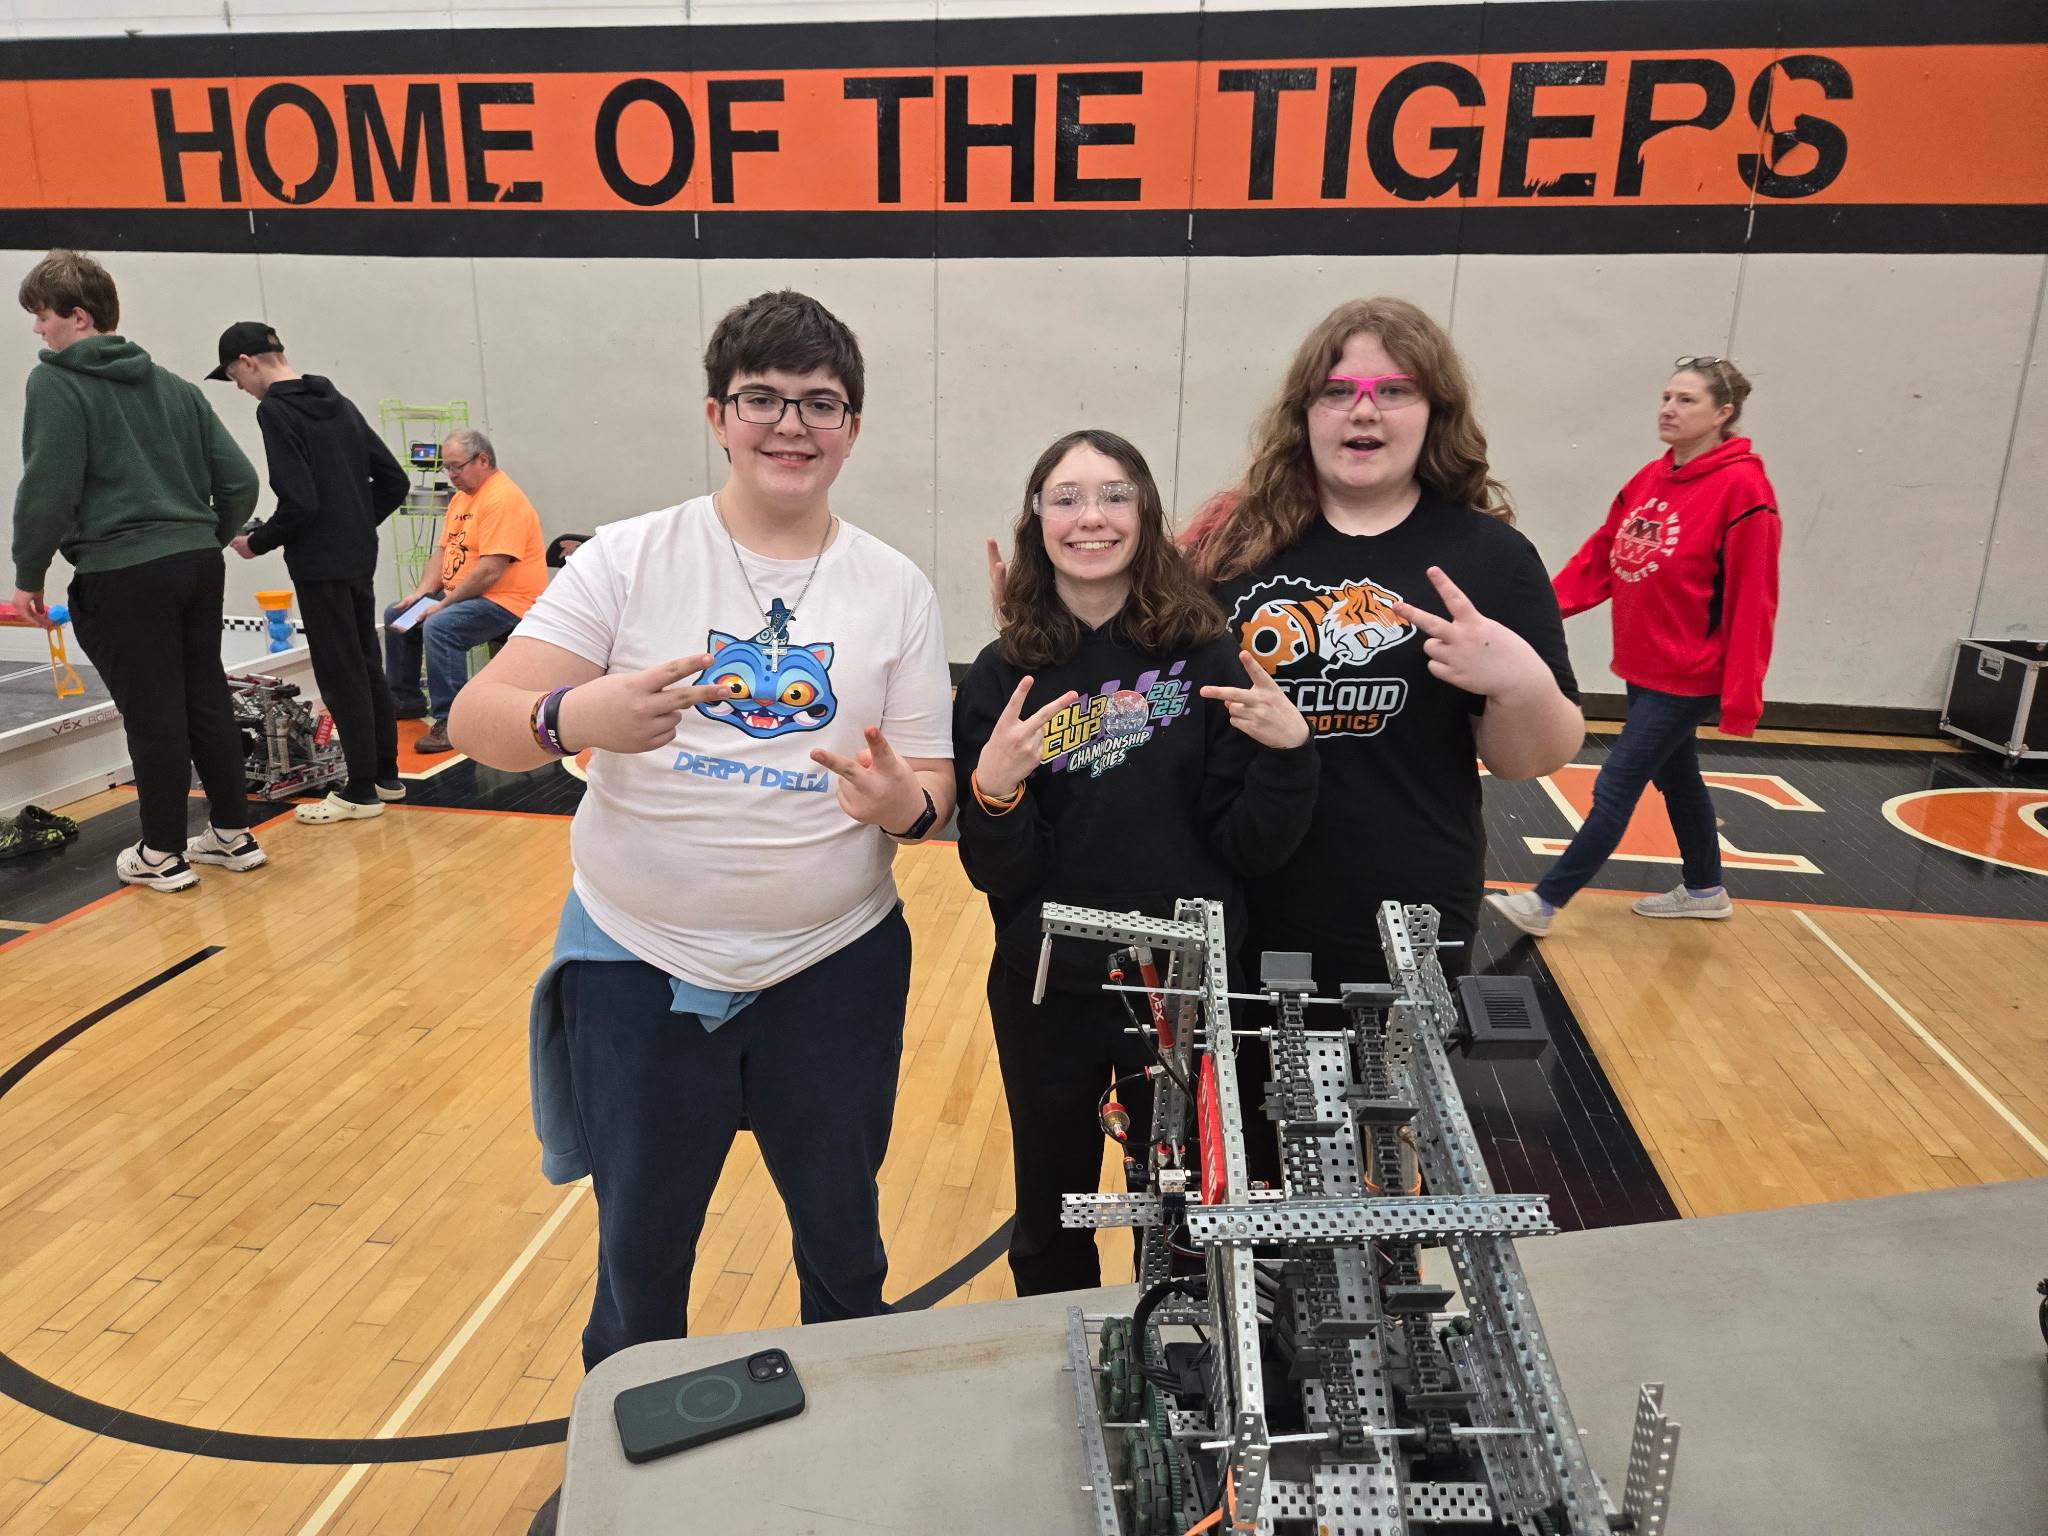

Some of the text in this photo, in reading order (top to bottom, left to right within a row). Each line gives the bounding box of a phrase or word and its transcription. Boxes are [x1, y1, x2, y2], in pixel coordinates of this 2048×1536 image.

[152, 83, 542, 204] HOME
[595, 78, 784, 206] OF
[844, 72, 1142, 203] THE
[1149, 680, 1181, 700] 20
[1296, 684, 1400, 711] CLOUD
[1153, 697, 1184, 717] 25
[51, 718, 83, 735] VEX
[1041, 717, 1103, 762] CUP
[673, 751, 829, 793] DERPY DELTA
[1150, 990, 1165, 1022] VEX
